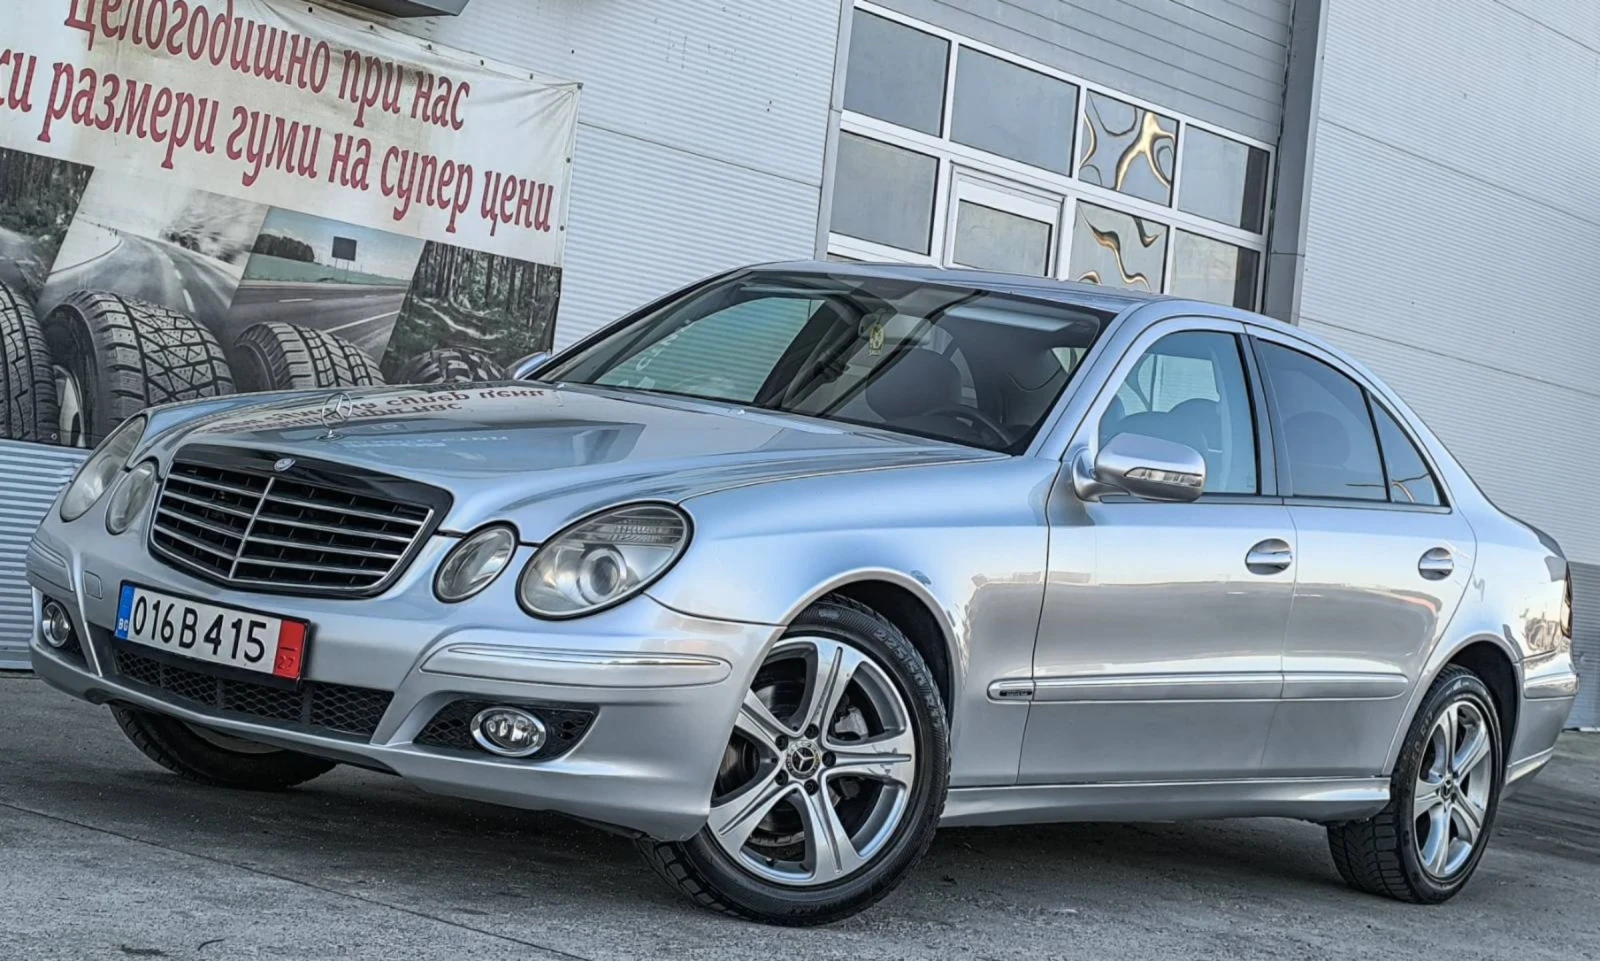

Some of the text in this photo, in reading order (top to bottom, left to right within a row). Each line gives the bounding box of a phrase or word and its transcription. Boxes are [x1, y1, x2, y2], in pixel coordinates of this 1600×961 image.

[341, 50, 402, 127] при
[411, 69, 470, 131] нас
[37, 62, 218, 169] размери
[226, 105, 322, 187] гуми
[328, 125, 371, 191] на
[380, 141, 472, 234] супер
[481, 170, 555, 237] цени
[118, 617, 129, 632] BG
[133, 596, 267, 664] 016B415
